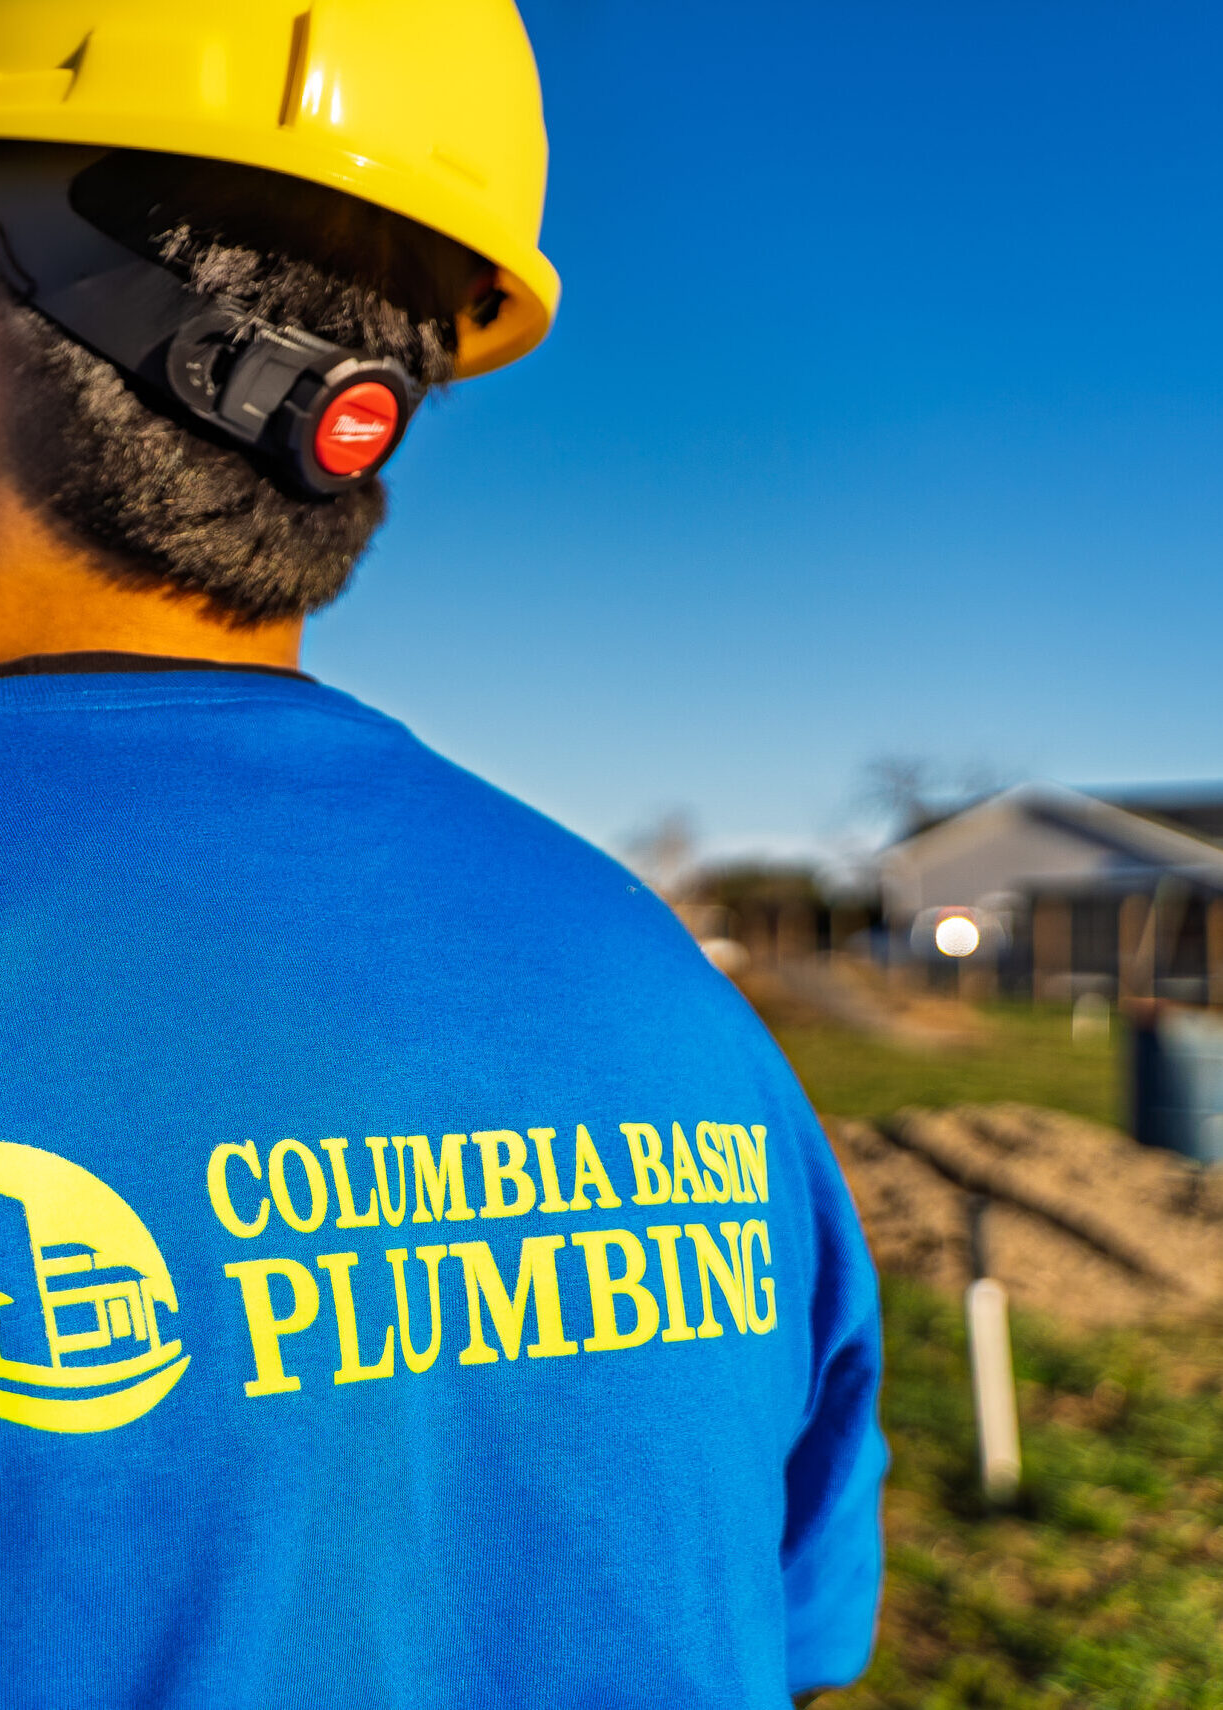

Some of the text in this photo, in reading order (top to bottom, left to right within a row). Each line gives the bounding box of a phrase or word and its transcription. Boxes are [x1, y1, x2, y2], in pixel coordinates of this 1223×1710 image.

[206, 1121, 768, 1239] COLUMBIA BASIN
[224, 1219, 776, 1398] PLUMBING
